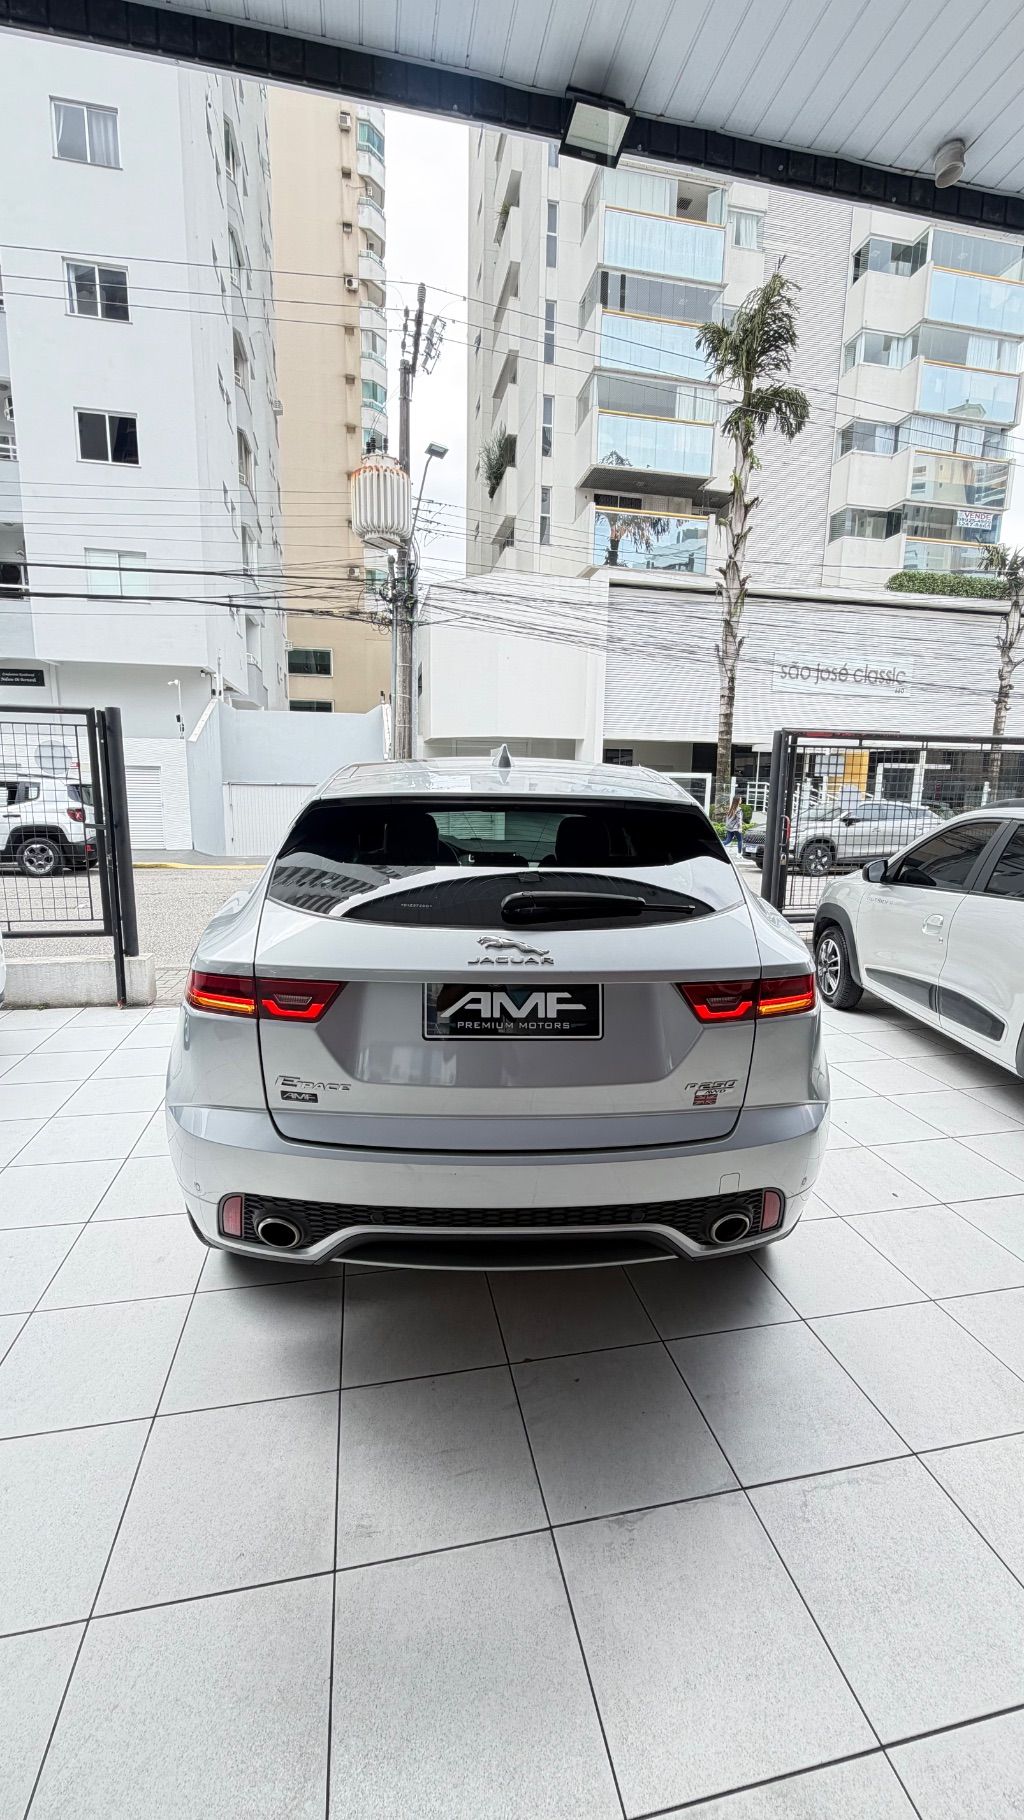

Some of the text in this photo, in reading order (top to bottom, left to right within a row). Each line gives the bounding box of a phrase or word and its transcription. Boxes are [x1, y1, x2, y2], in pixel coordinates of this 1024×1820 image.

[964, 512, 991, 520] VENDE
[780, 662, 811, 680] são
[854, 664, 906, 685] classic
[467, 956, 555, 965] JAGUAR
[440, 991, 588, 1019] AMF
[457, 1021, 571, 1030] PREMIUM MOTORS
[684, 1079, 739, 1091] P250
[282, 1092, 316, 1101] AMF
